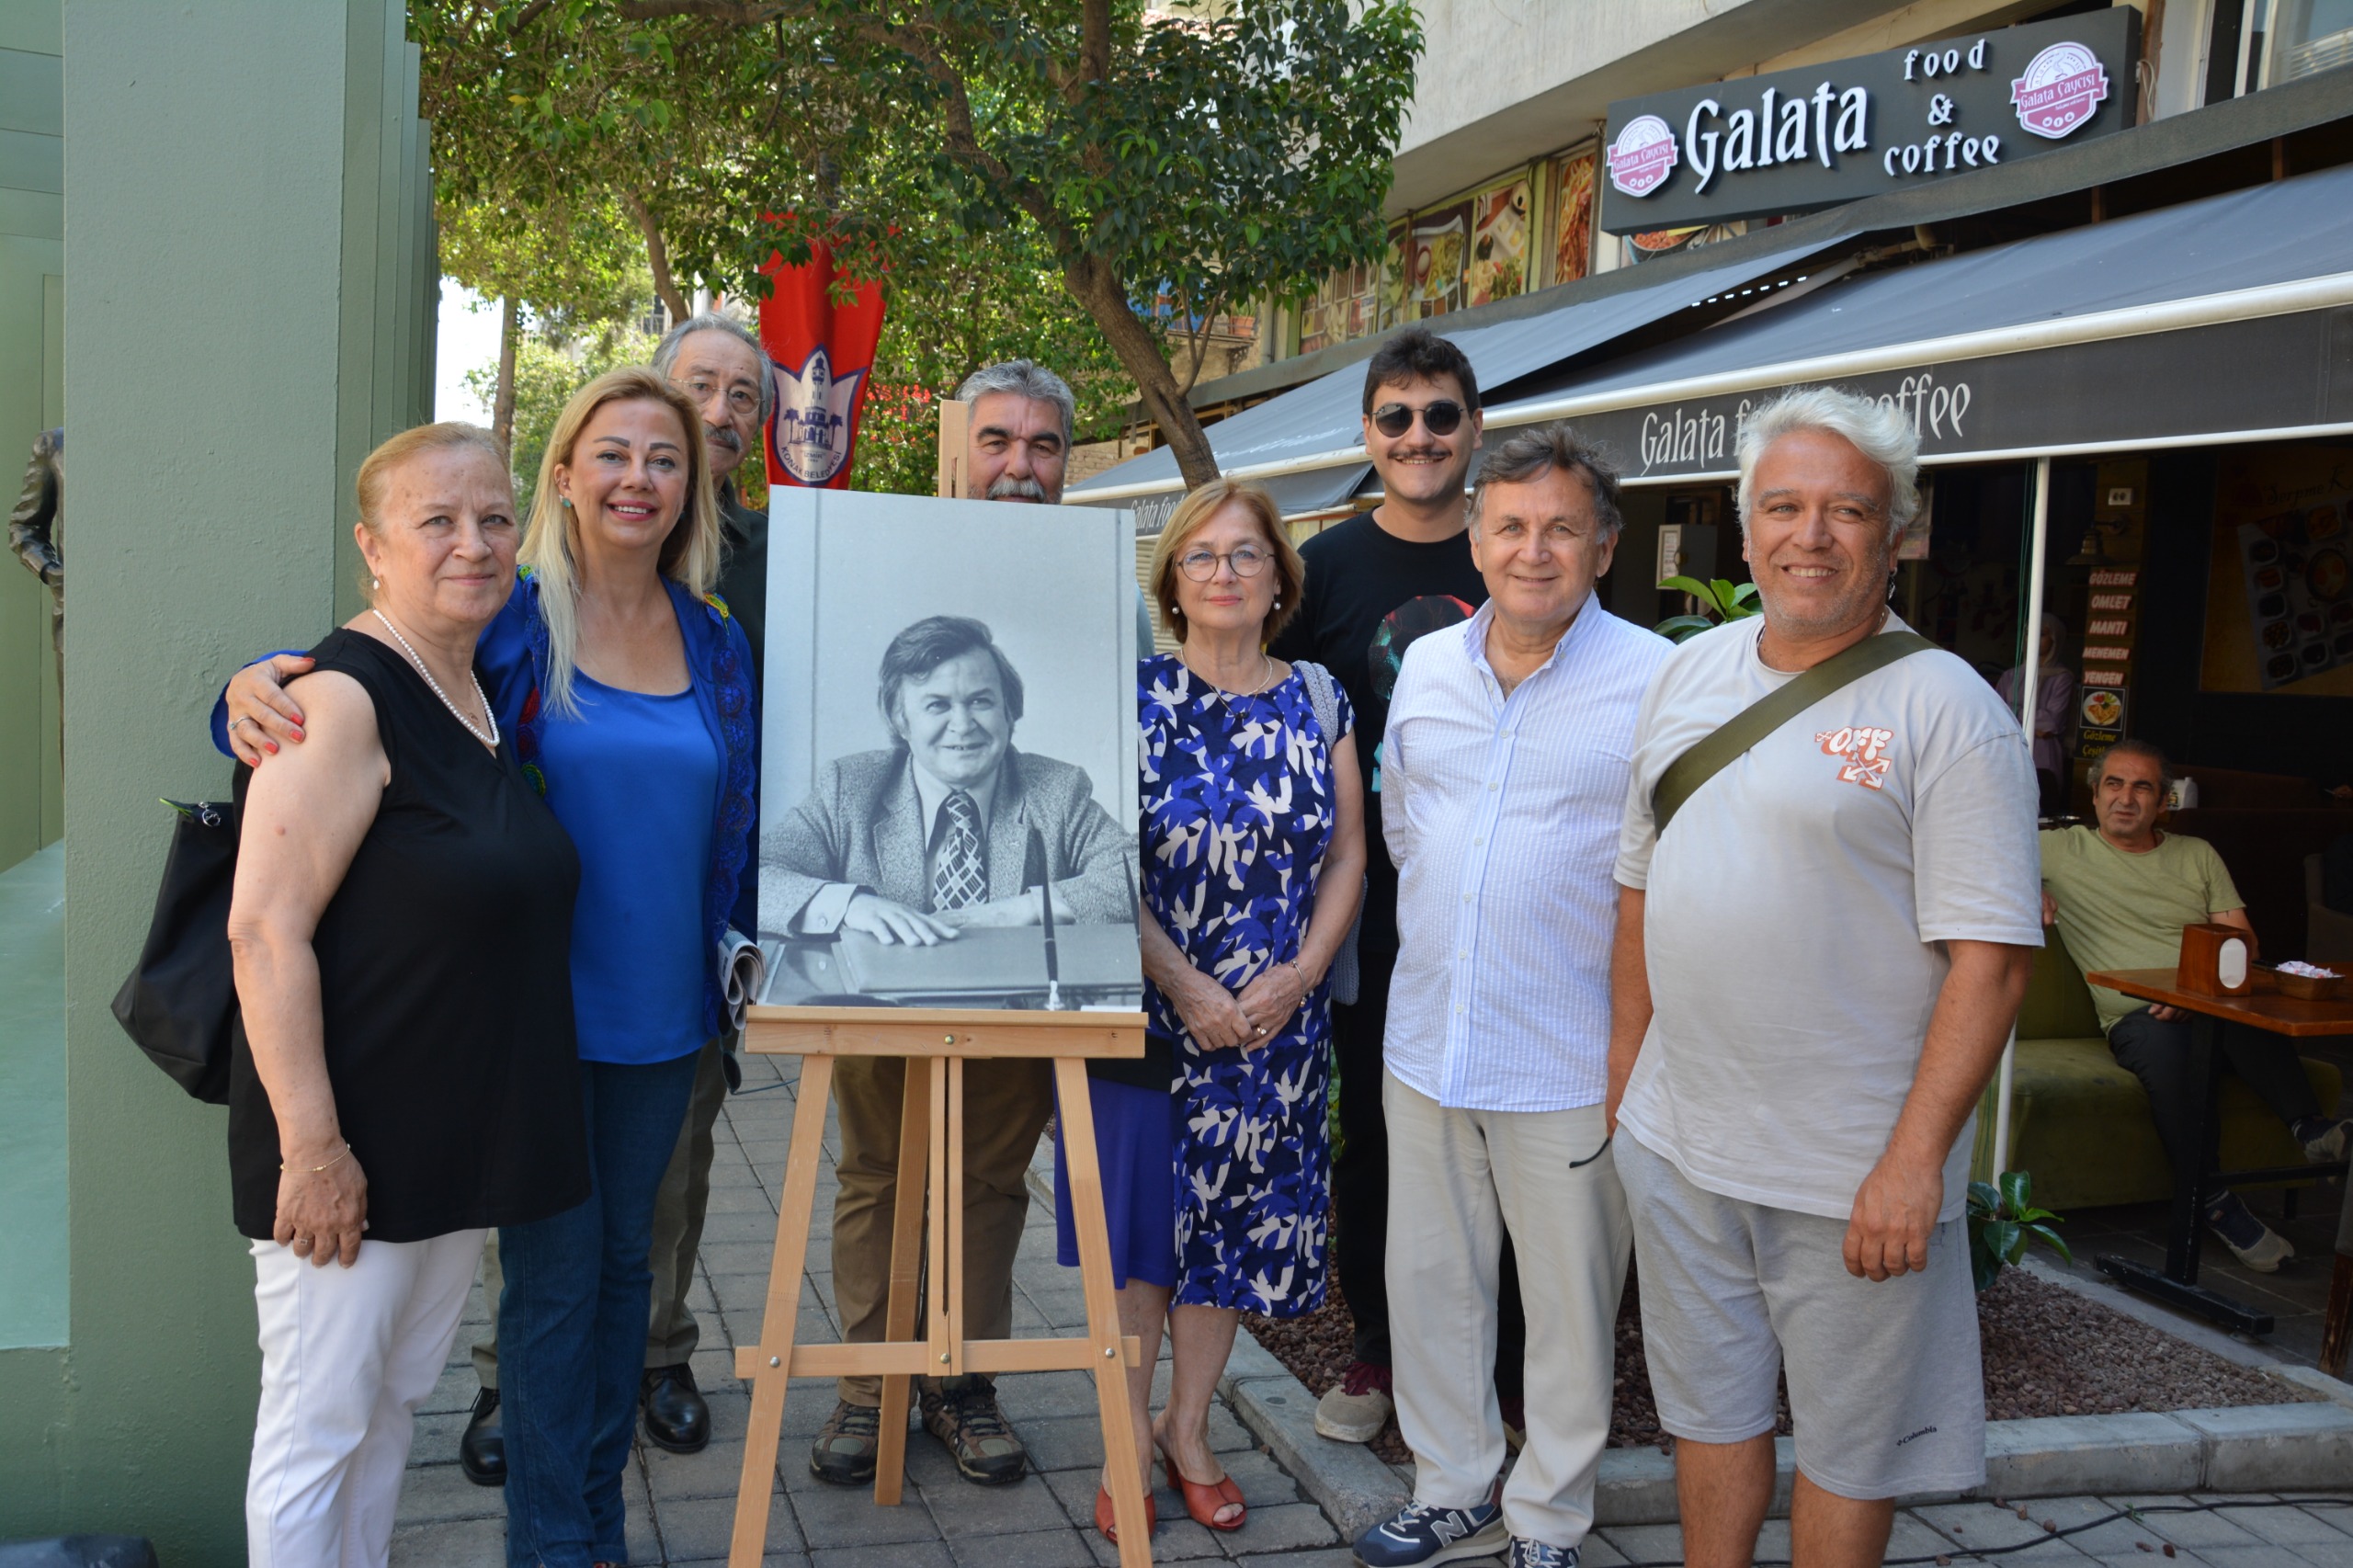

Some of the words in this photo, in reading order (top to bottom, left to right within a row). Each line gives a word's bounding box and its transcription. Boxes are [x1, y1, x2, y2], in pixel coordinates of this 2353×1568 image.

[1904, 38, 1986, 81] food
[2020, 89, 2054, 109] Galata
[1927, 93, 1954, 126] &
[1685, 80, 1869, 195] Galata
[1613, 154, 1639, 171] Galata
[1883, 131, 2000, 176] coffee
[1863, 373, 1972, 439] ffee
[1641, 408, 1726, 477] Galata
[780, 446, 803, 476] KONAK
[2088, 569, 2137, 586] GÖZLEME
[2091, 594, 2132, 610] OMLET
[2088, 619, 2129, 636] MANTI
[2082, 646, 2130, 661] MENEMEN
[2083, 670, 2124, 687] YENGEN
[2083, 729, 2117, 743] Gözleme
[1903, 1425, 1938, 1445] Columbia
